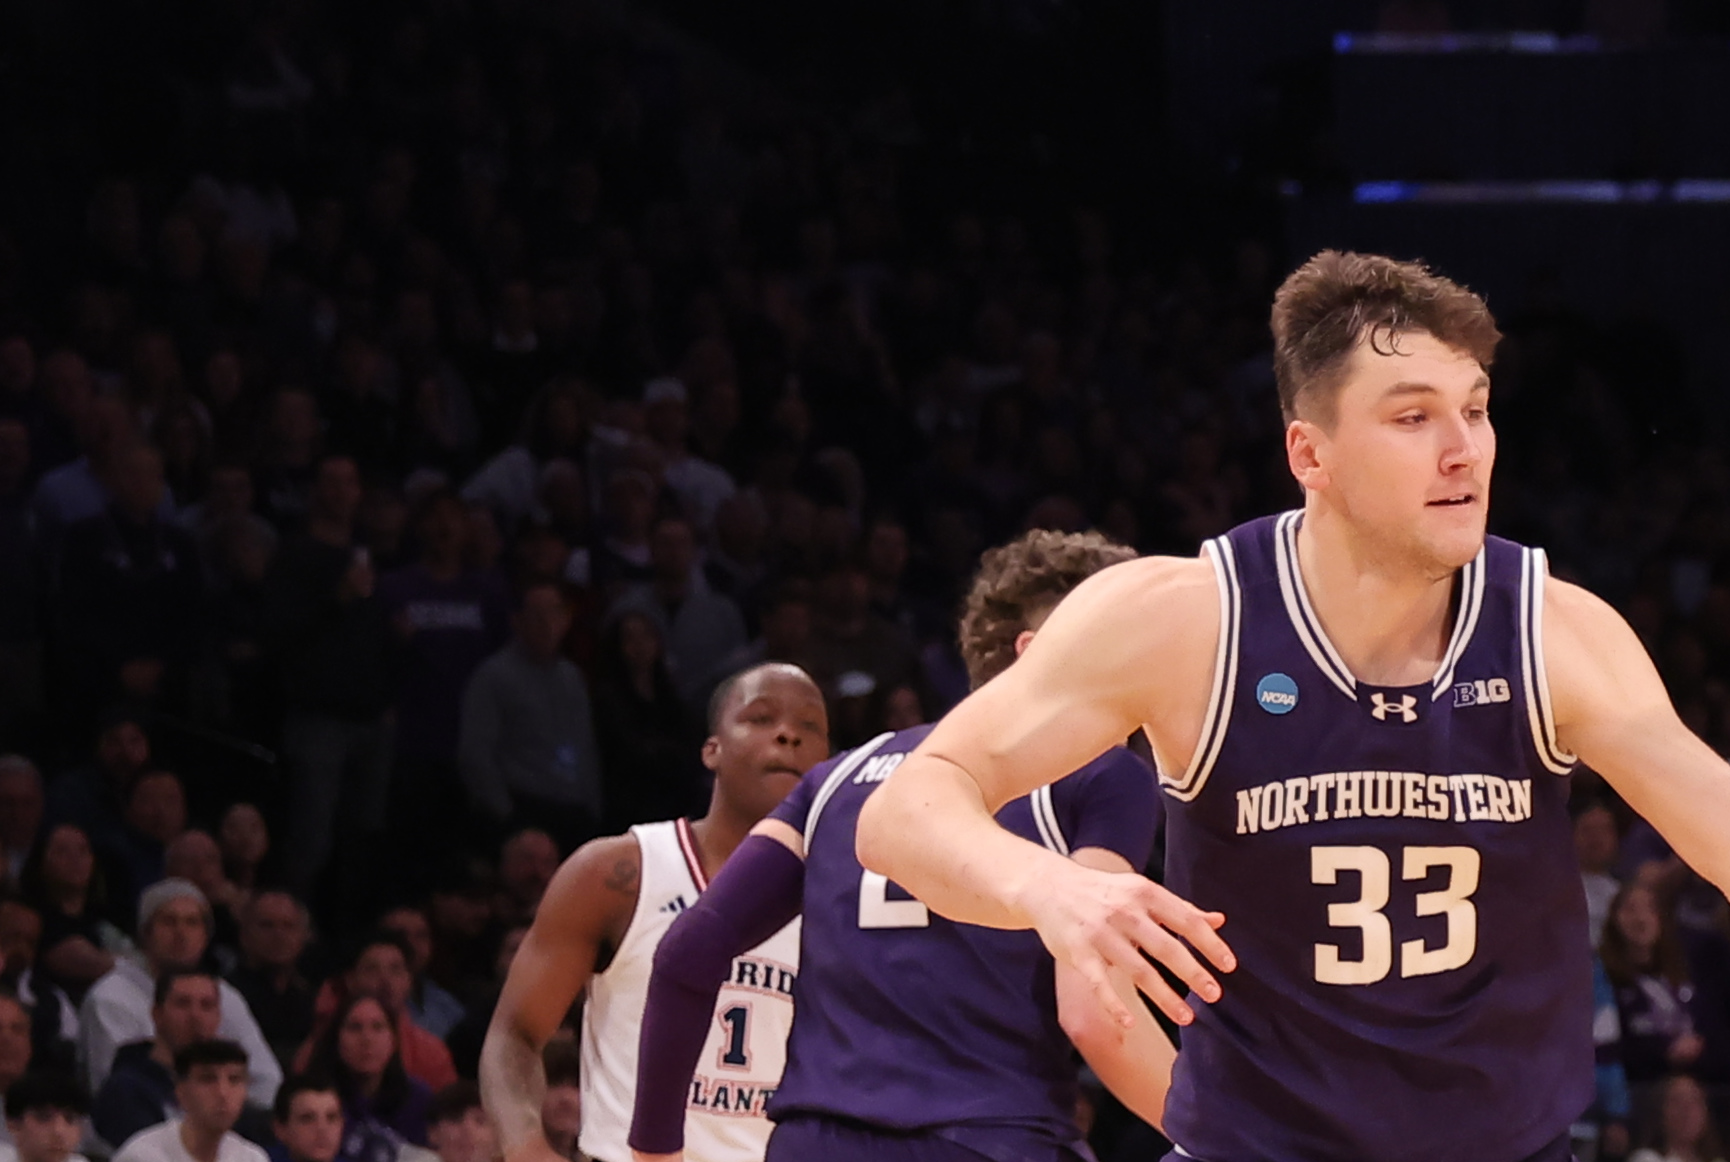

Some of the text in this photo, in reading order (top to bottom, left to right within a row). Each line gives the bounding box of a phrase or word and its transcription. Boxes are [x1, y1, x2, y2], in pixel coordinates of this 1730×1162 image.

[1261, 690, 1296, 707] NCAA
[853, 752, 912, 785] MA
[1236, 771, 1532, 835] NORTHWESTERN
[1310, 845, 1481, 986] 33
[725, 961, 795, 995] RID
[719, 1002, 751, 1070] 1
